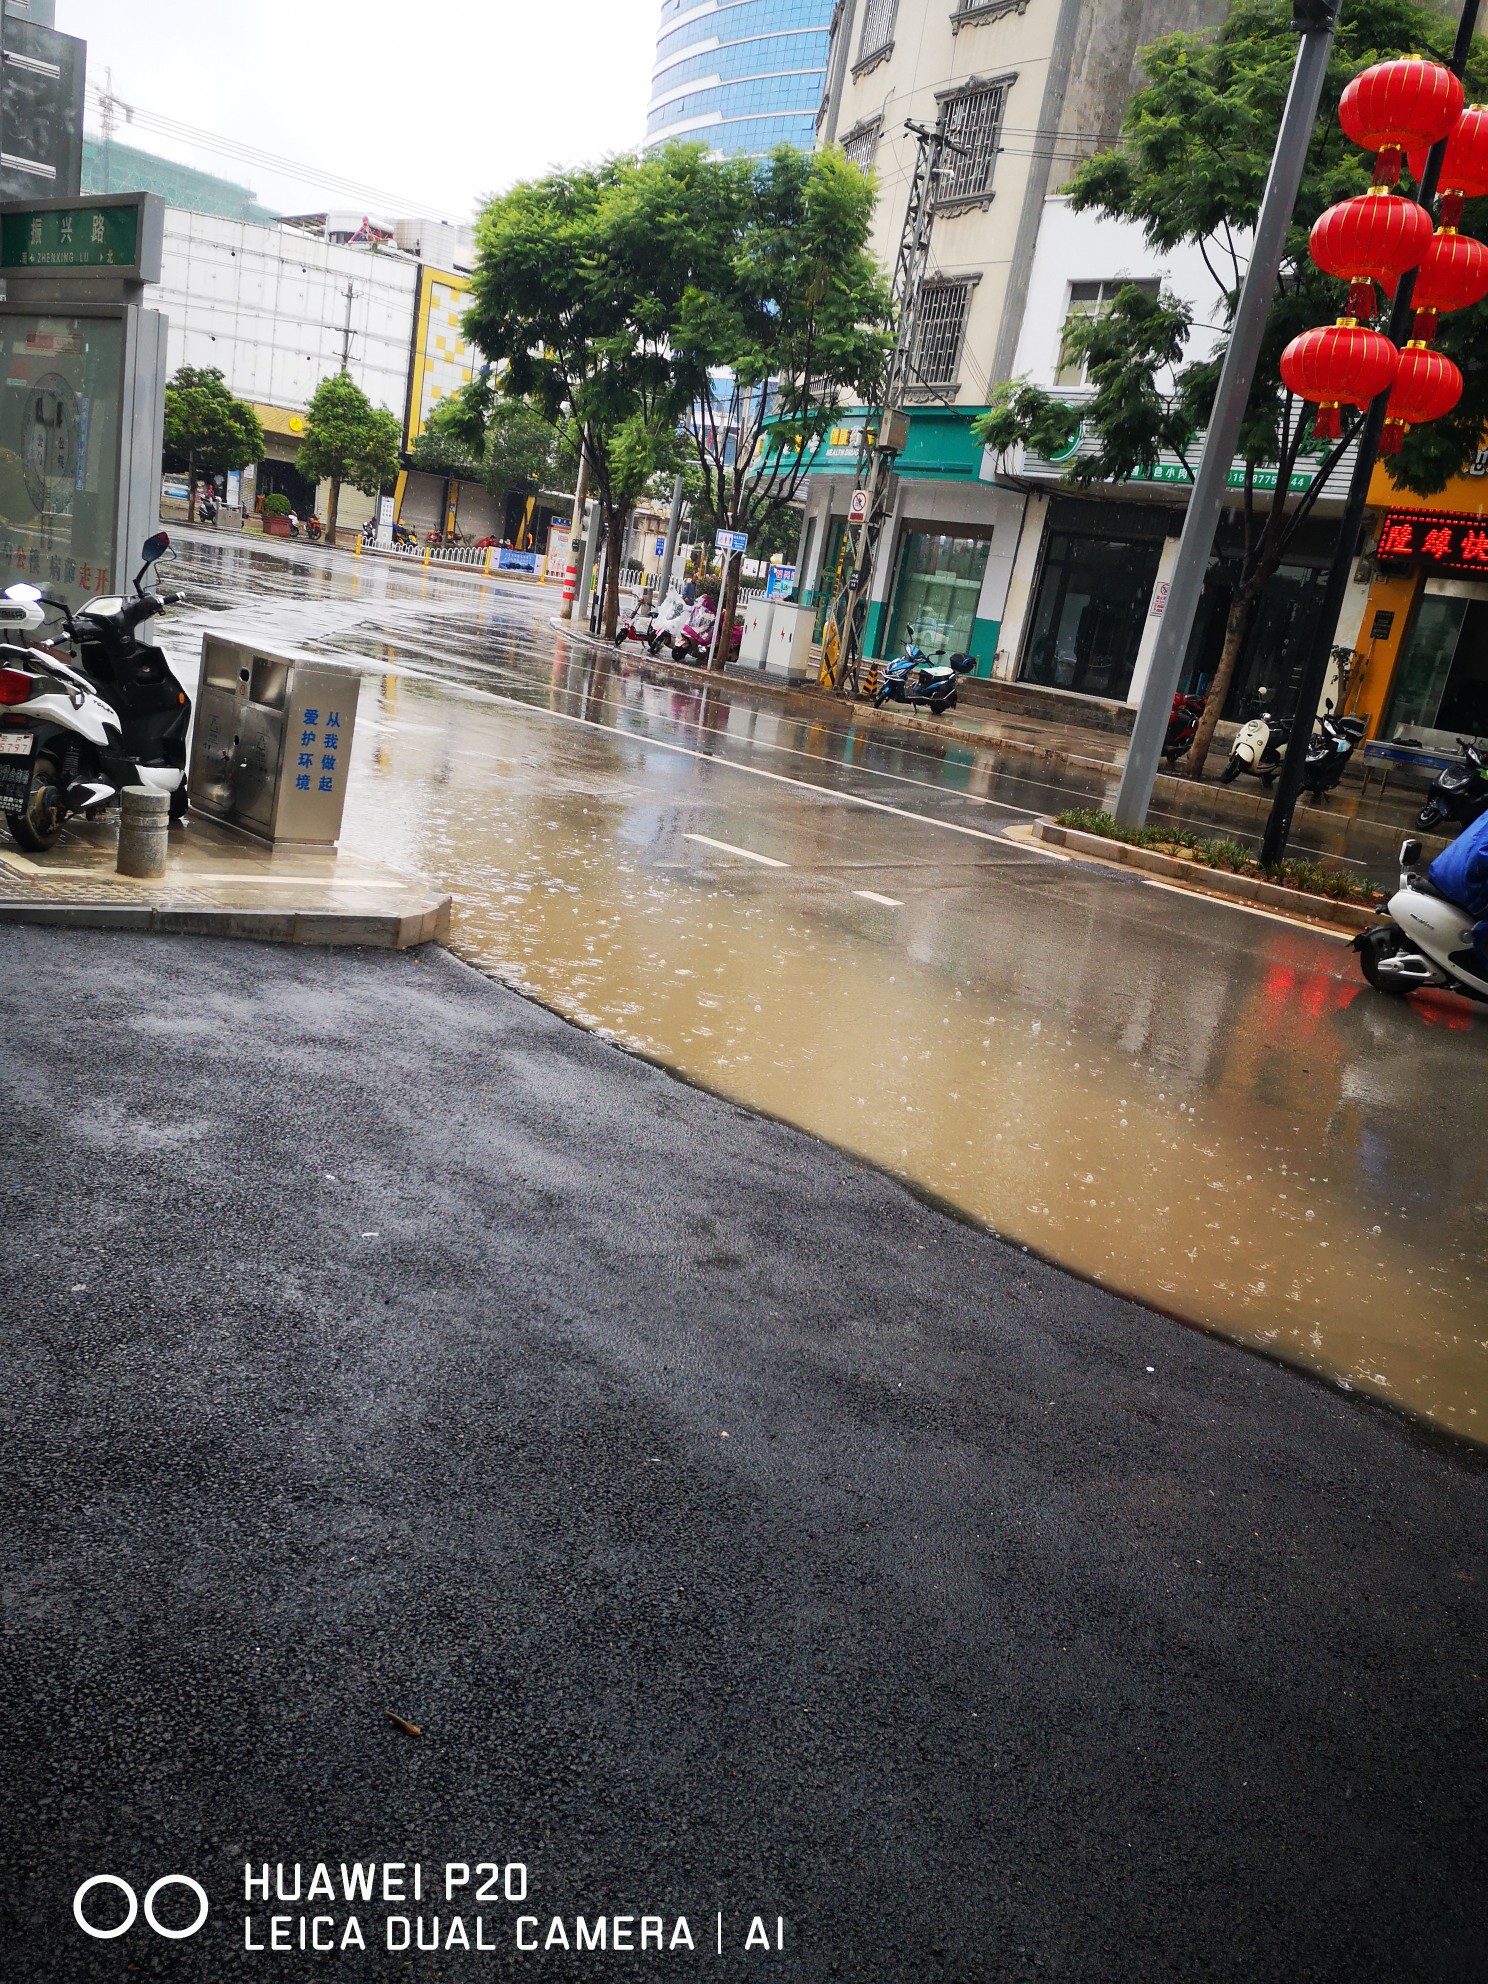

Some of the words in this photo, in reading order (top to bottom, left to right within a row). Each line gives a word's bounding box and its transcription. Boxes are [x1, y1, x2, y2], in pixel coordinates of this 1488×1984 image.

[30, 214, 106, 245] 振兴路
[37, 252, 74, 264] ZHENXING
[79, 252, 89, 263] LU
[106, 249, 114, 264] 北
[1233, 473, 1304, 487] 15877544
[295, 708, 319, 790] 爱护环境
[318, 711, 341, 792] 从我做起
